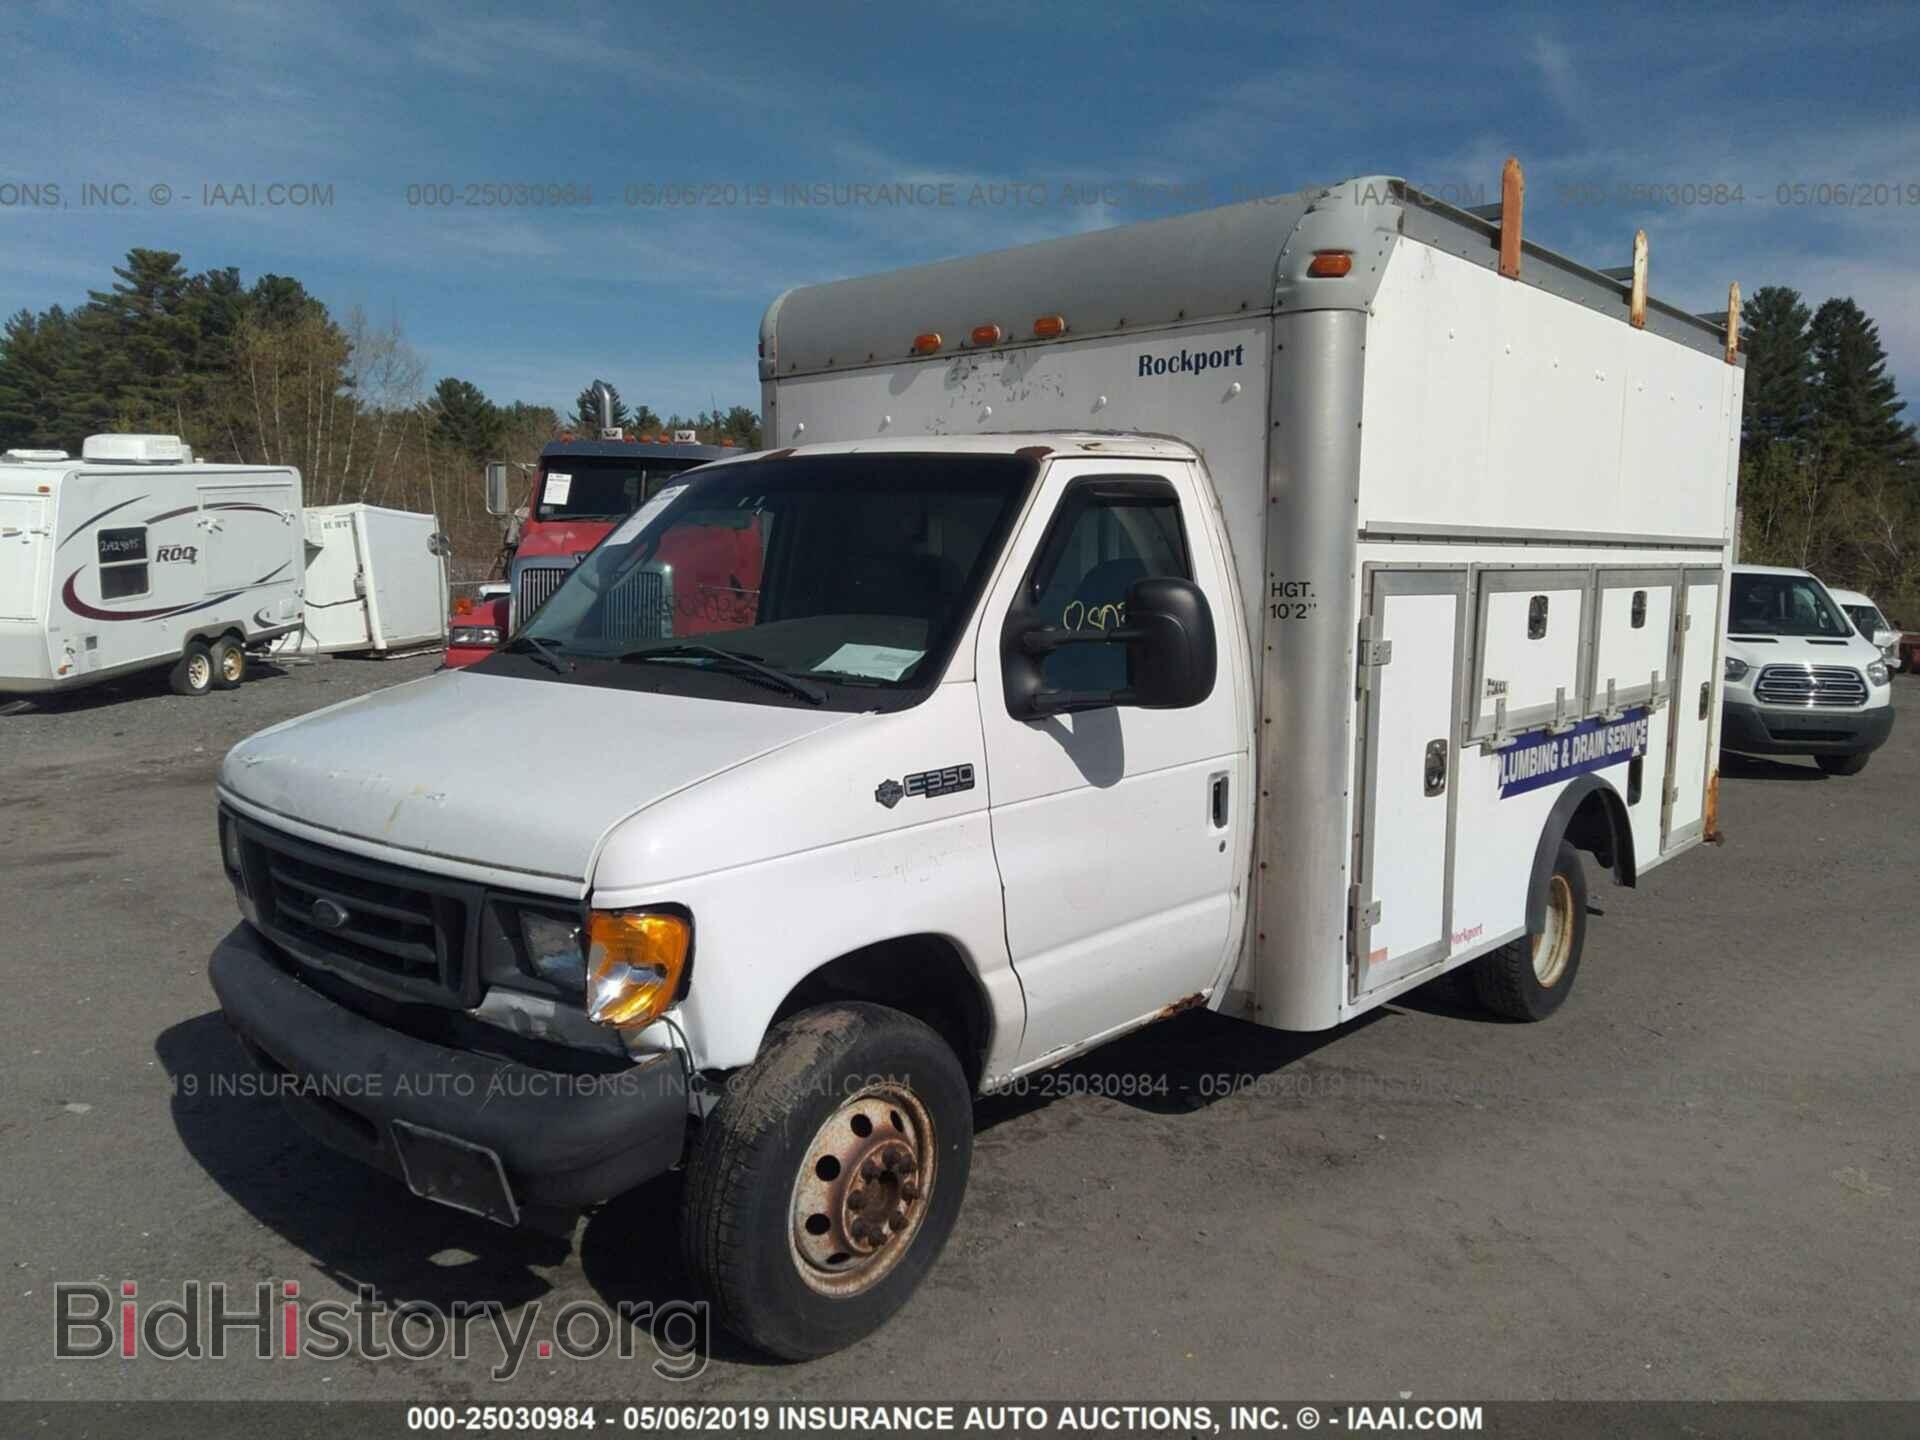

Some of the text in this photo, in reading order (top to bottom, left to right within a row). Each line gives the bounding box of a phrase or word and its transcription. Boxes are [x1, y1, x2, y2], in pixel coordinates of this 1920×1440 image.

[1138, 344, 1244, 377] Rockport
[1271, 582, 1316, 598] HGT.
[1561, 738, 1570, 768] &
[1572, 728, 1606, 765] DRAIN
[1608, 719, 1648, 754] SERVICE
